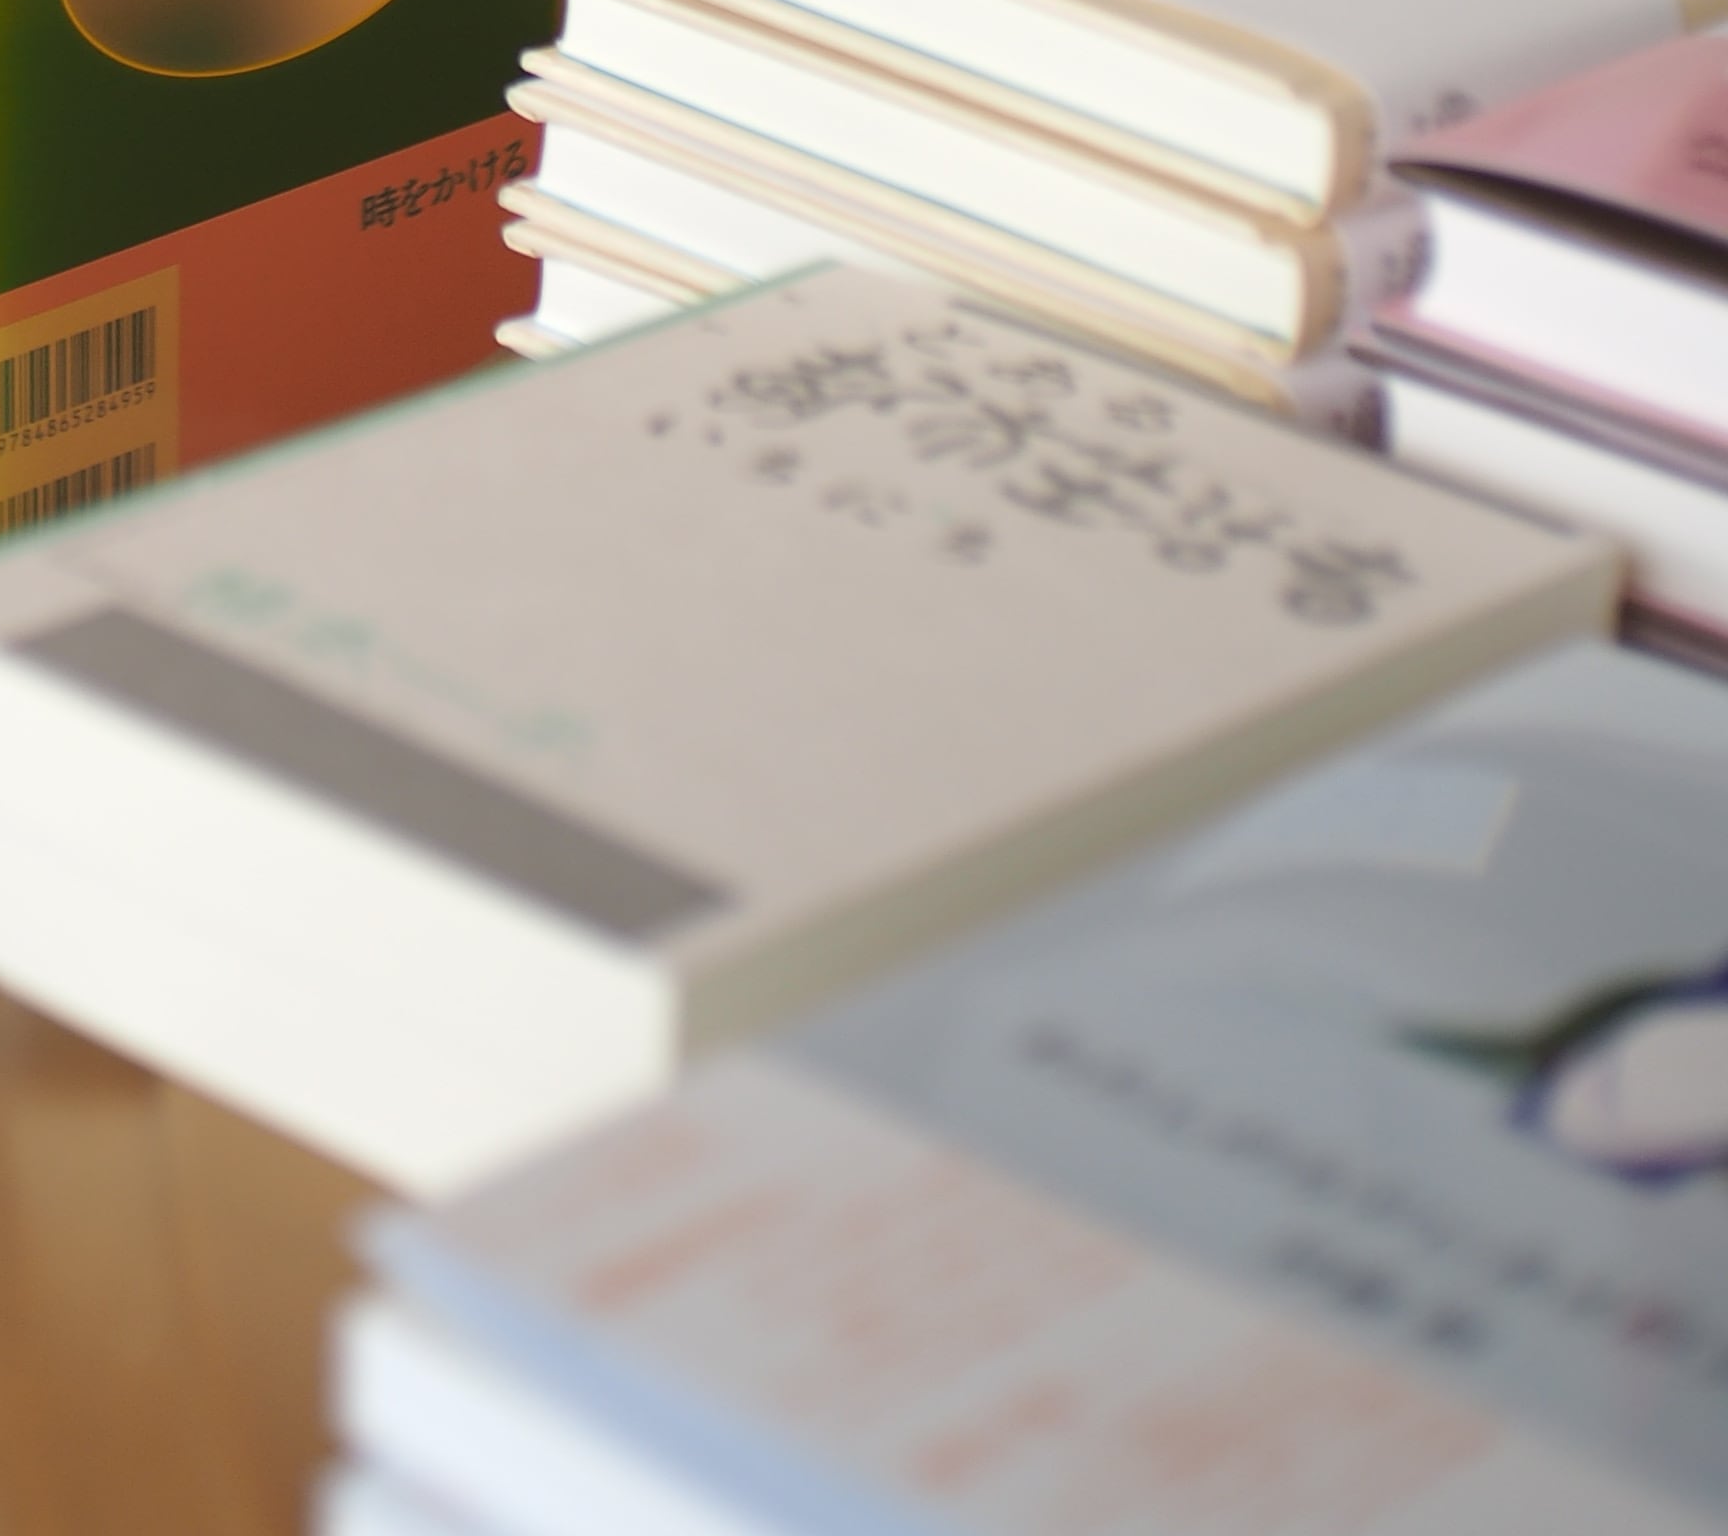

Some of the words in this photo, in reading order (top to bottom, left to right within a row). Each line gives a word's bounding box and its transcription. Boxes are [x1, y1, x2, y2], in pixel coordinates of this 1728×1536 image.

[358, 138, 531, 231] 時をかける
